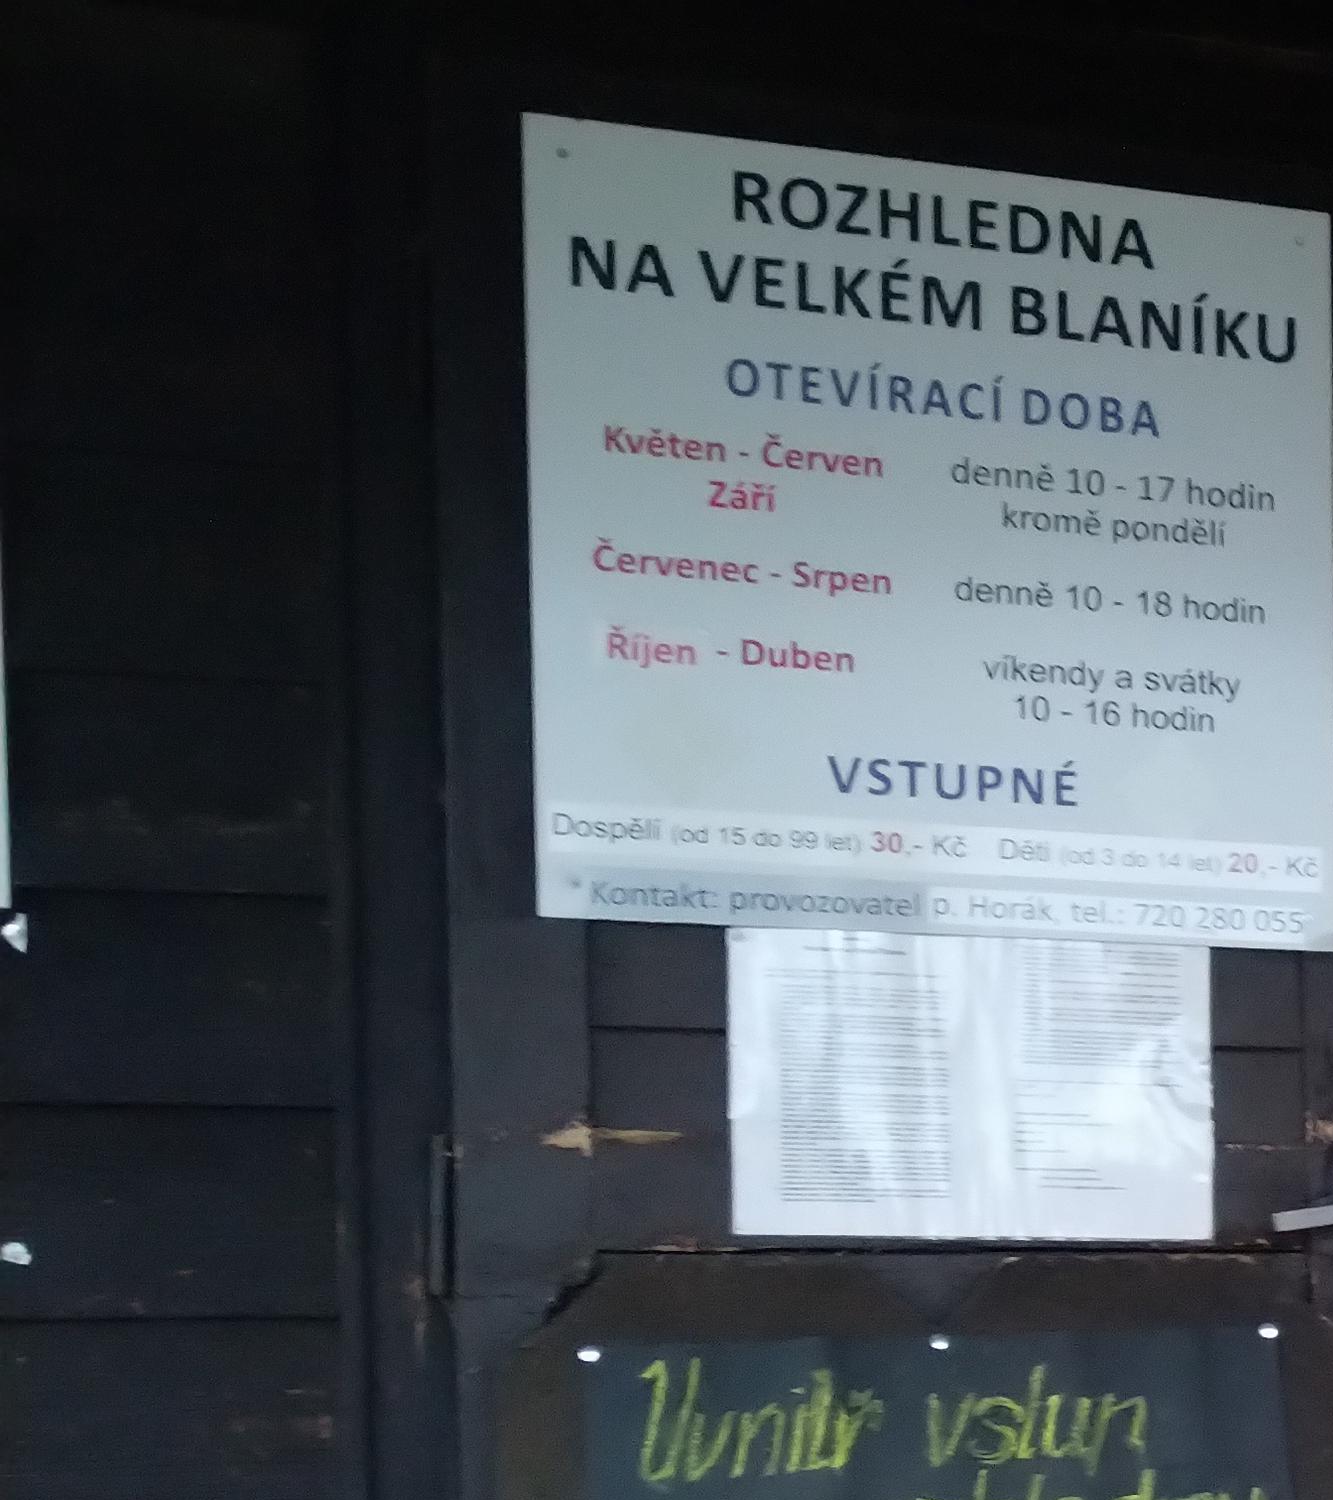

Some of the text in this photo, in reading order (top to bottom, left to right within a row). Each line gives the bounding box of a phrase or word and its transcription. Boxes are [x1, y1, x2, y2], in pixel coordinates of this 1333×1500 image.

[732, 170, 1155, 271] ROZHLEDNA
[569, 236, 1297, 364] NA VELKÉM BLANÍKU
[726, 358, 1160, 438] OTEVÍRACÍ DOBA
[604, 425, 726, 462] Květen
[762, 432, 884, 477] Červen
[708, 480, 777, 512] Září
[951, 457, 1054, 492] denně
[1067, 468, 1104, 497] 10
[1138, 475, 1175, 503] 17
[1187, 477, 1276, 512] hodin
[1002, 502, 1226, 548] kromě pondělí
[592, 536, 759, 584] Červenec
[792, 561, 892, 597] Srpen
[954, 577, 1053, 608] denně
[1067, 585, 1102, 612] 10
[1138, 590, 1172, 618] 18
[1184, 595, 1265, 625] hodin
[607, 625, 697, 669] Říjen
[741, 638, 855, 673] Duben
[983, 654, 1241, 703] víkendy a svátky
[1016, 695, 1049, 722] 10
[1086, 700, 1120, 726] 16
[1132, 702, 1215, 733] hodin
[828, 754, 1079, 807] VSTUPNÉ
[553, 812, 661, 843] Dospělí
[671, 820, 708, 845] (od
[720, 827, 746, 846] 15
[754, 829, 781, 848] do
[790, 830, 818, 849] 99
[870, 831, 923, 857] 30,-
[931, 835, 967, 859] Kč
[998, 837, 1051, 862] Děti
[1101, 848, 1114, 865] 3
[1122, 849, 1149, 867] do
[1158, 852, 1181, 868] 14
[1285, 855, 1319, 879] Kč
[590, 879, 719, 910] Kontakt:
[729, 888, 921, 917] provozovatel
[932, 897, 957, 919] p.
[1135, 903, 1186, 928] 720
[1198, 906, 1246, 931] 280
[1256, 909, 1304, 934] 055
